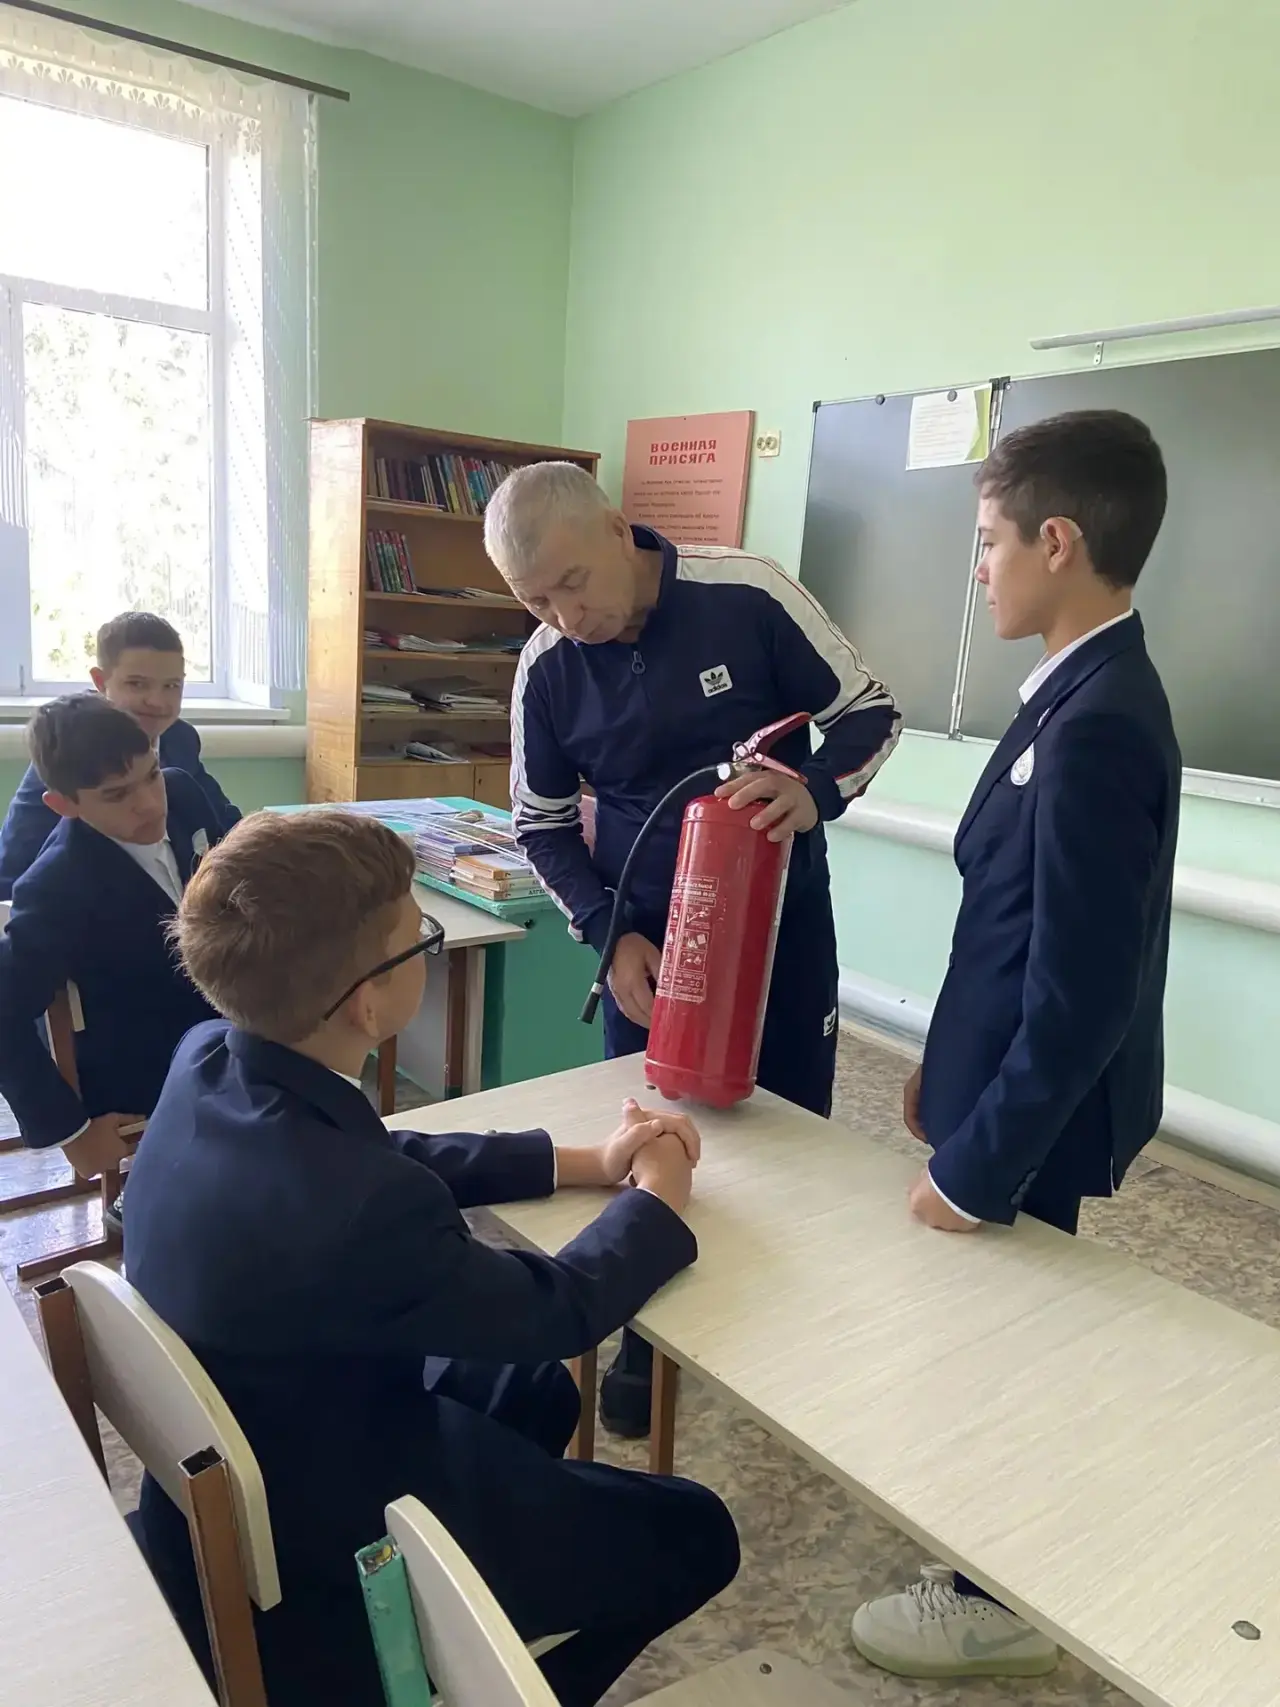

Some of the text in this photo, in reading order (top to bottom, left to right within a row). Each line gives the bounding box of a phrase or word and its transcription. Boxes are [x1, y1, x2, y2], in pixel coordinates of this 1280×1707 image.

[651, 440, 716, 453] ВОЕННАЯ
[649, 453, 716, 465] ПРИСЯГА
[708, 683, 728, 693] adidas
